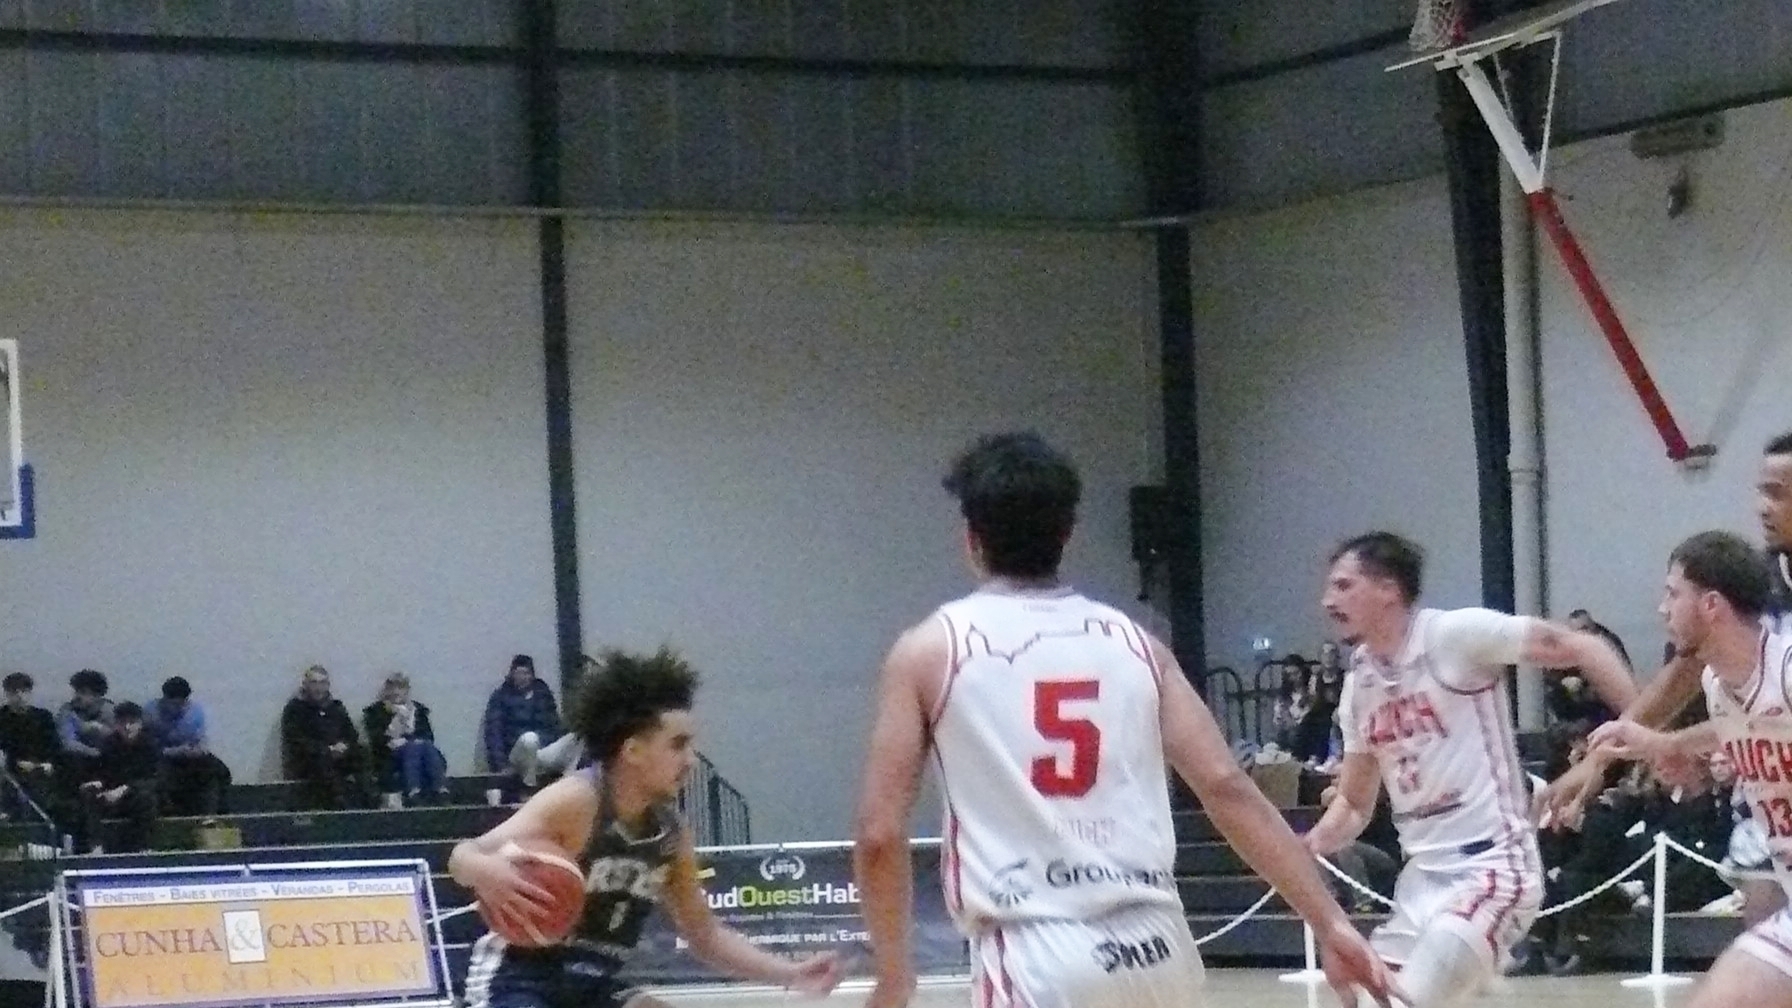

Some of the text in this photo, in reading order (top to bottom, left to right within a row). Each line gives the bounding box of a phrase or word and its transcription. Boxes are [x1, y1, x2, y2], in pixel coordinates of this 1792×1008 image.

[1031, 679, 1101, 798] 5
[347, 881, 410, 895] PERGOLAS
[701, 883, 862, 909] udOuestHab
[96, 918, 418, 957] CUNHA & CASTERA
[108, 960, 418, 997] ALUMINIUM
